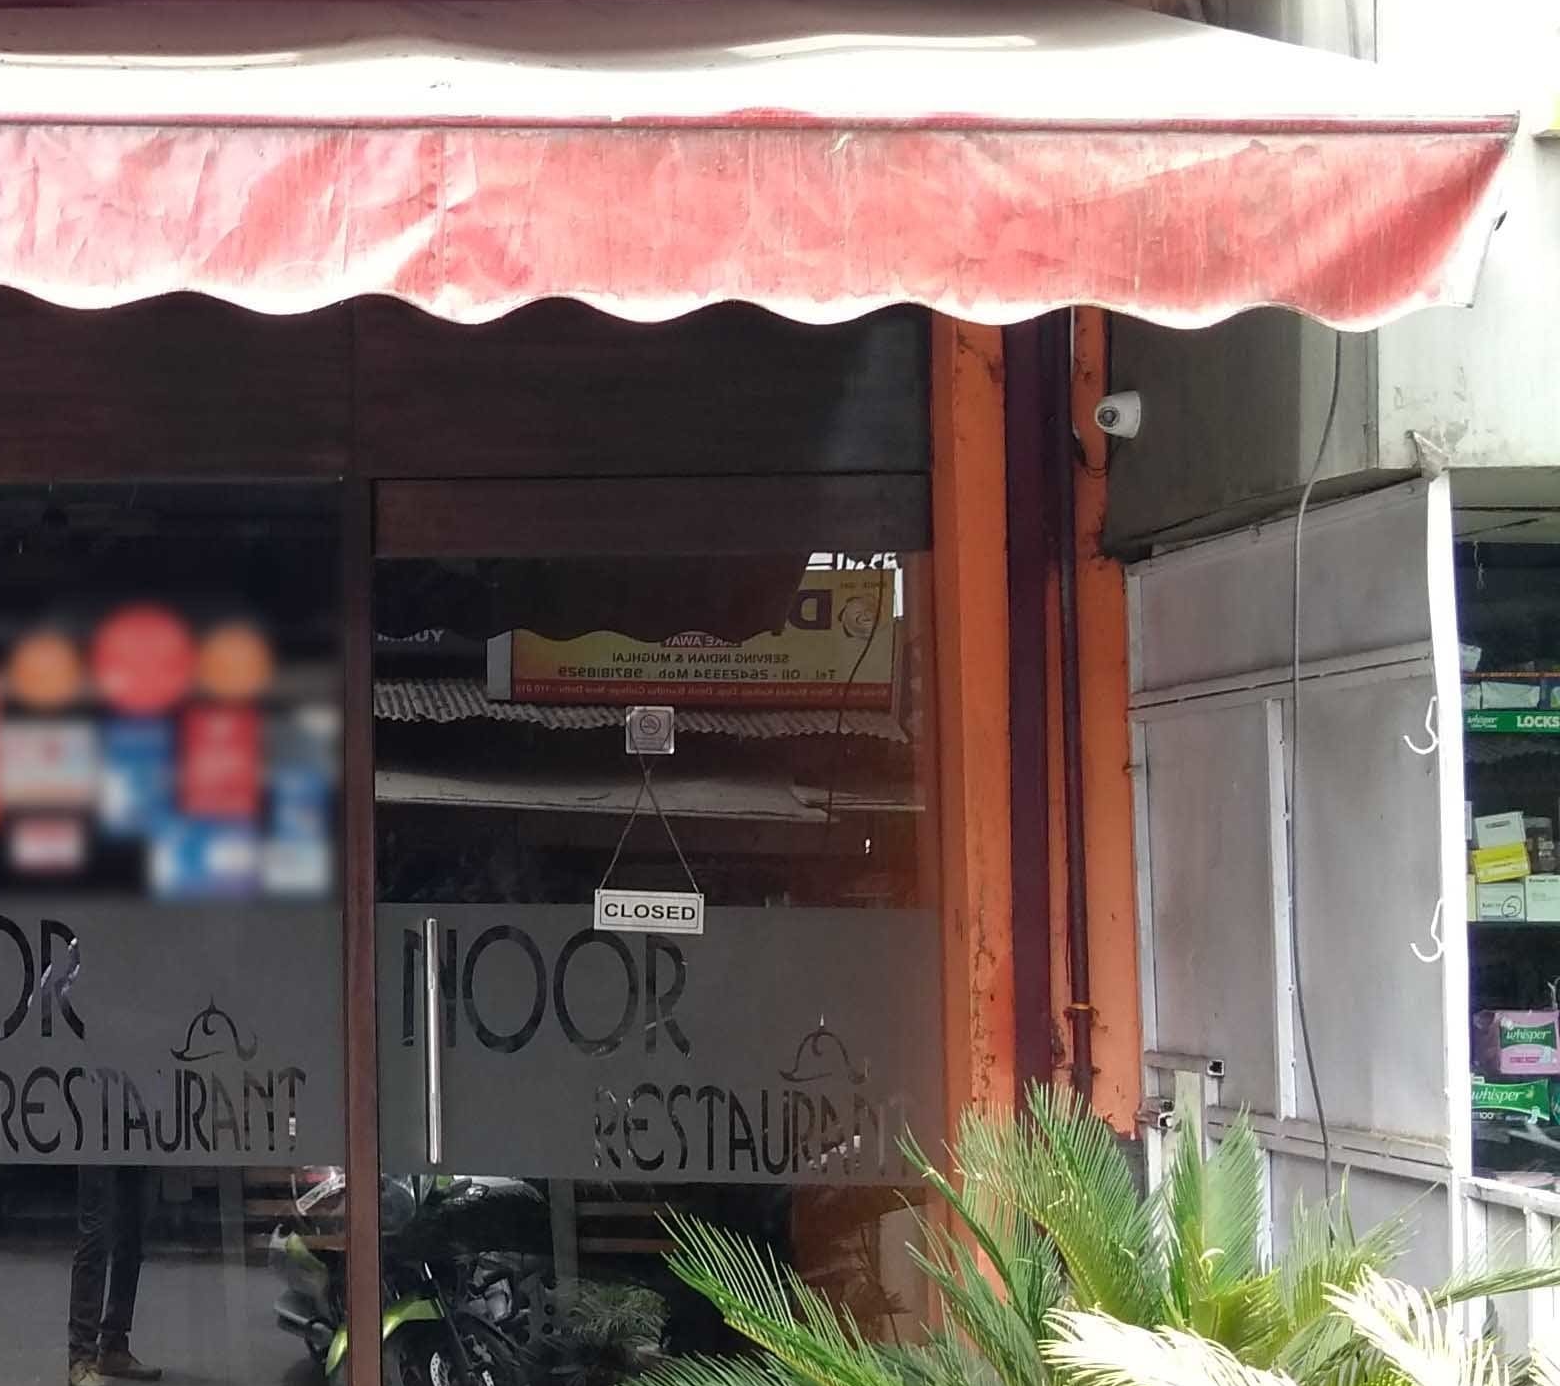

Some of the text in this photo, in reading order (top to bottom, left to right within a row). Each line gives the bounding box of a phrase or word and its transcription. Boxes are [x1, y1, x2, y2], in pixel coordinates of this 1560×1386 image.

[603, 901, 697, 922] CLOSED
[400, 924, 693, 1059] NOOR
[1506, 1029, 1551, 1044] whisper
[593, 1083, 913, 1180] RESTAURANT
